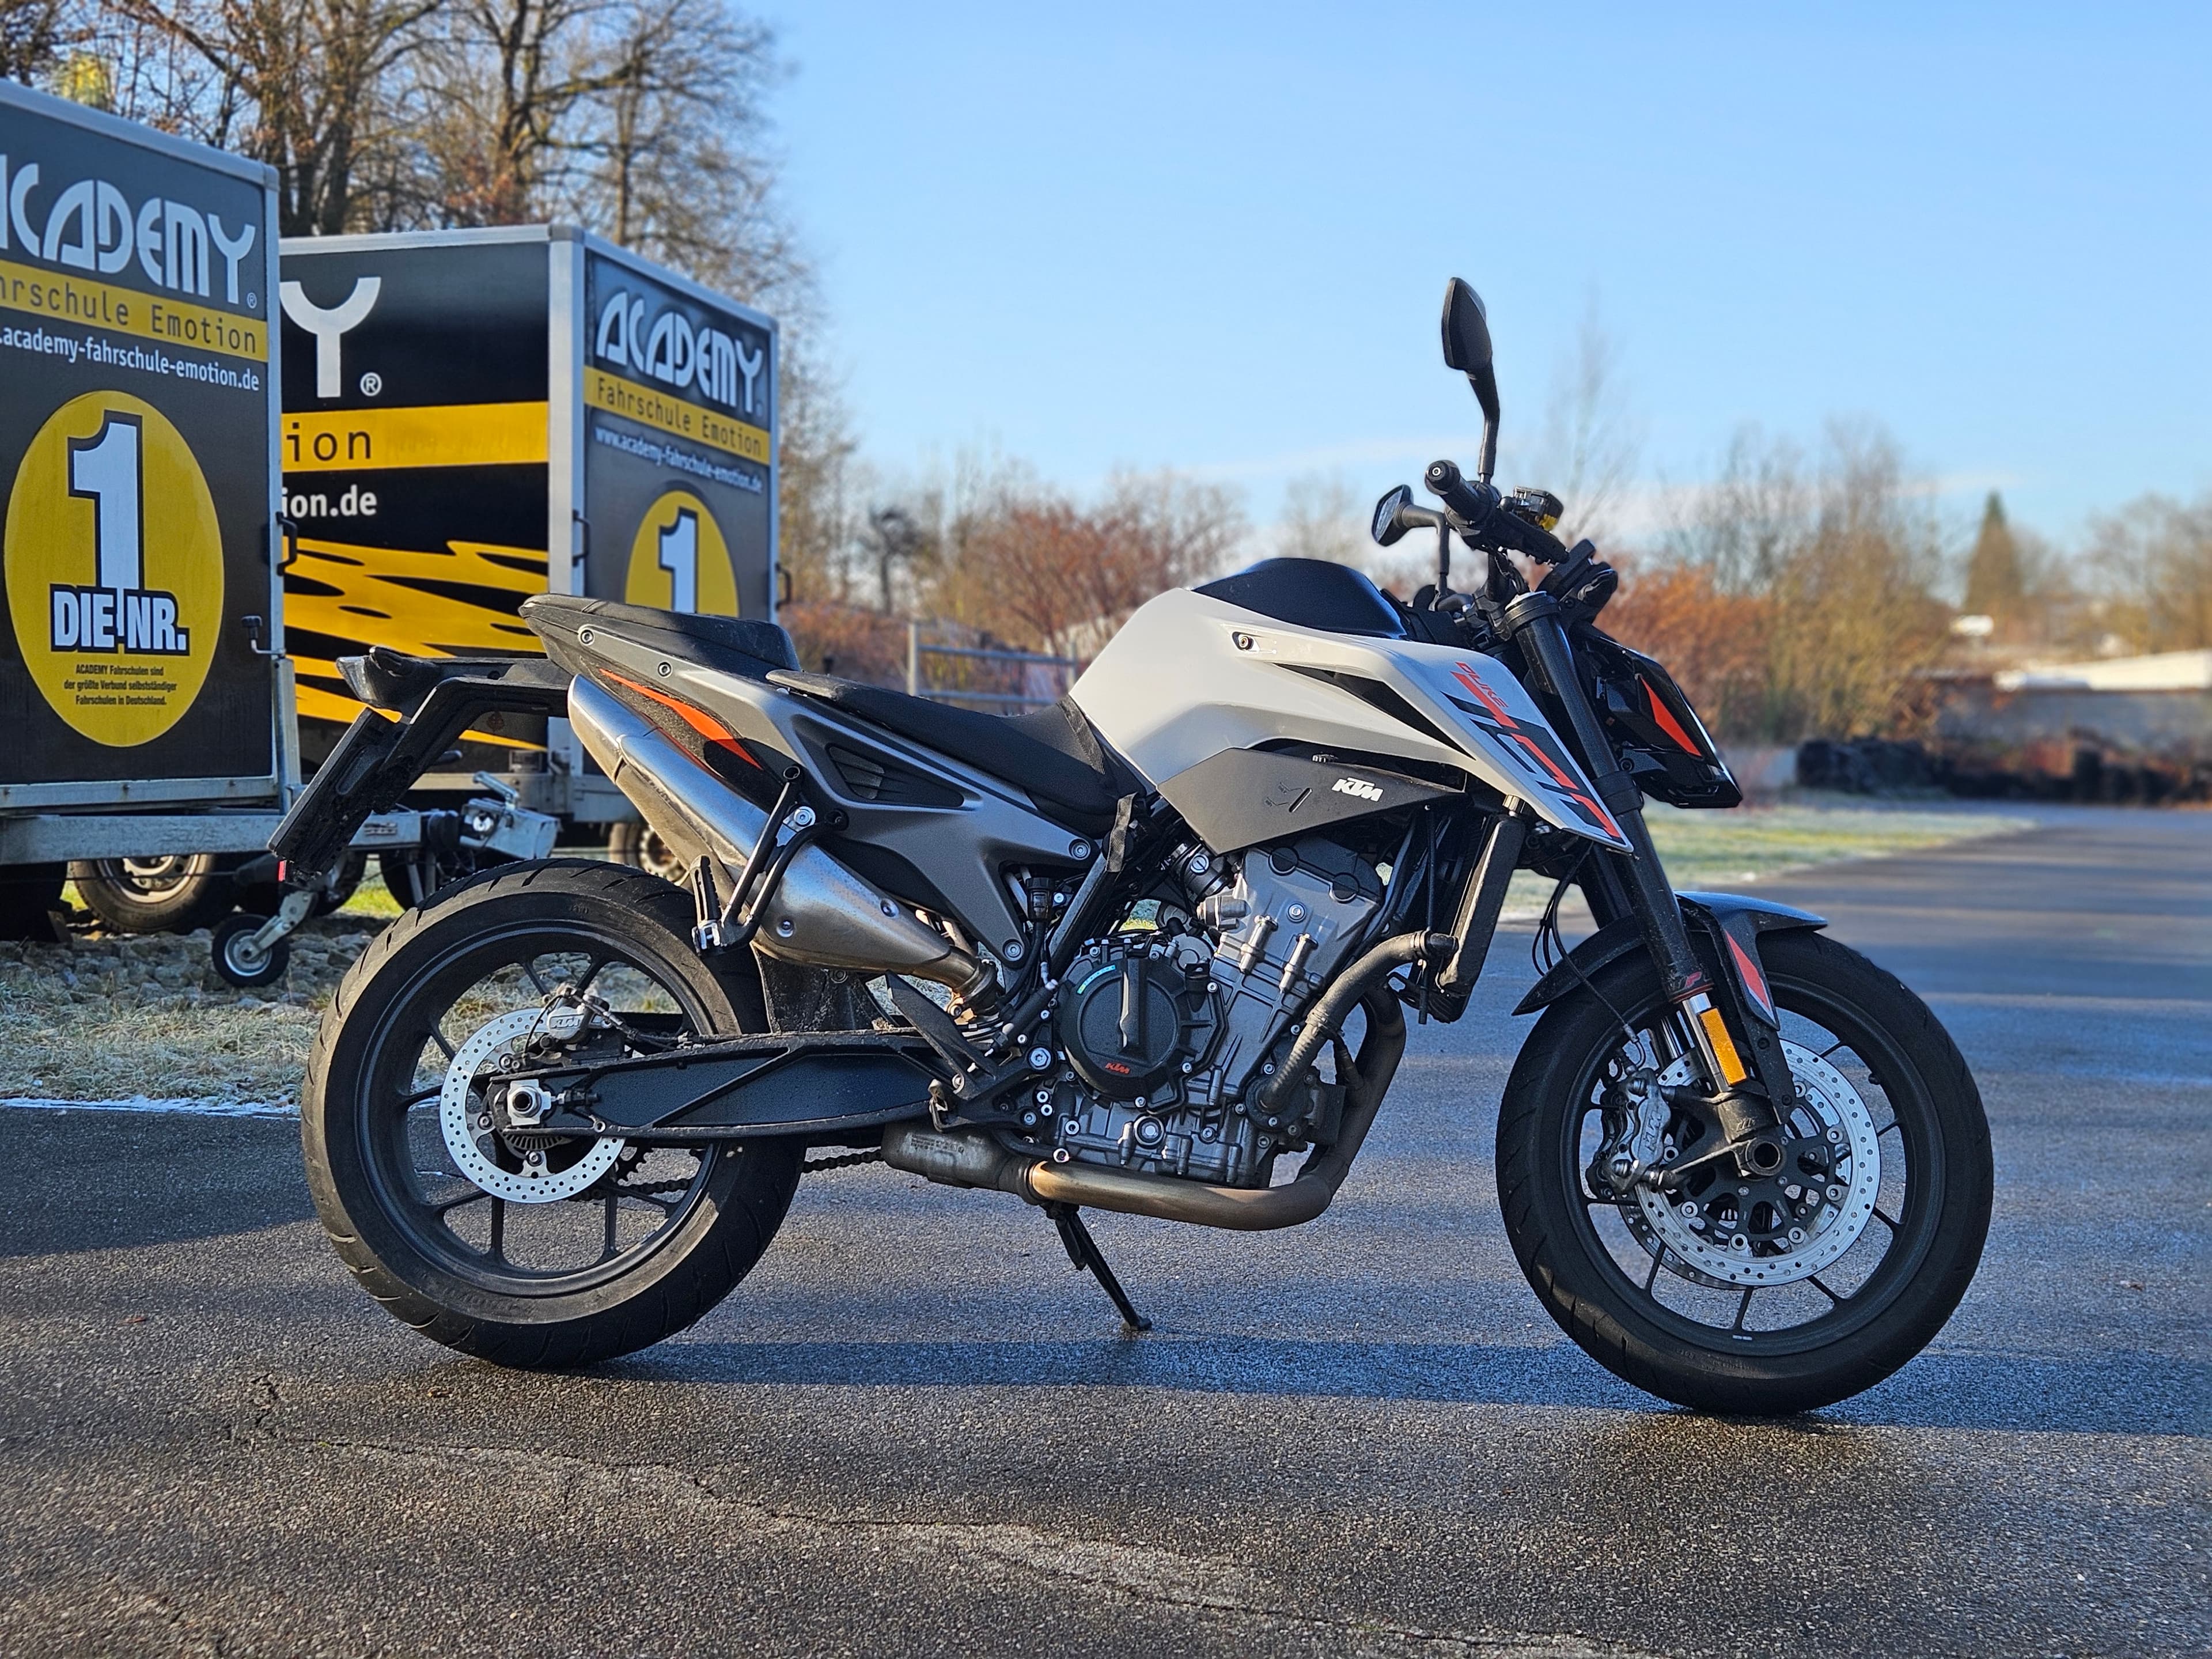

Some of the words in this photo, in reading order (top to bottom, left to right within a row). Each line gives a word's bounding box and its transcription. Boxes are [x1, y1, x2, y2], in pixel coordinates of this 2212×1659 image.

[0, 154, 256, 304] CADEMY
[151, 304, 255, 354] Emotion
[596, 291, 763, 414] ACADEMY
[598, 377, 691, 431] Fahrschule
[702, 415, 761, 456] Emotion
[74, 422, 139, 589] 1
[54, 591, 115, 647] DIE
[127, 596, 187, 650] NR.
[64, 679, 75, 690] der
[75, 664, 108, 675] ACADEMY
[109, 665, 149, 675] Fahrschulen
[150, 666, 164, 676] sind
[1455, 661, 1509, 708] DUKE
[75, 695, 116, 705] Fahrschulen
[118, 696, 124, 705] in
[1331, 777, 1384, 802] KTM
[1105, 1062, 1130, 1074] KTM
